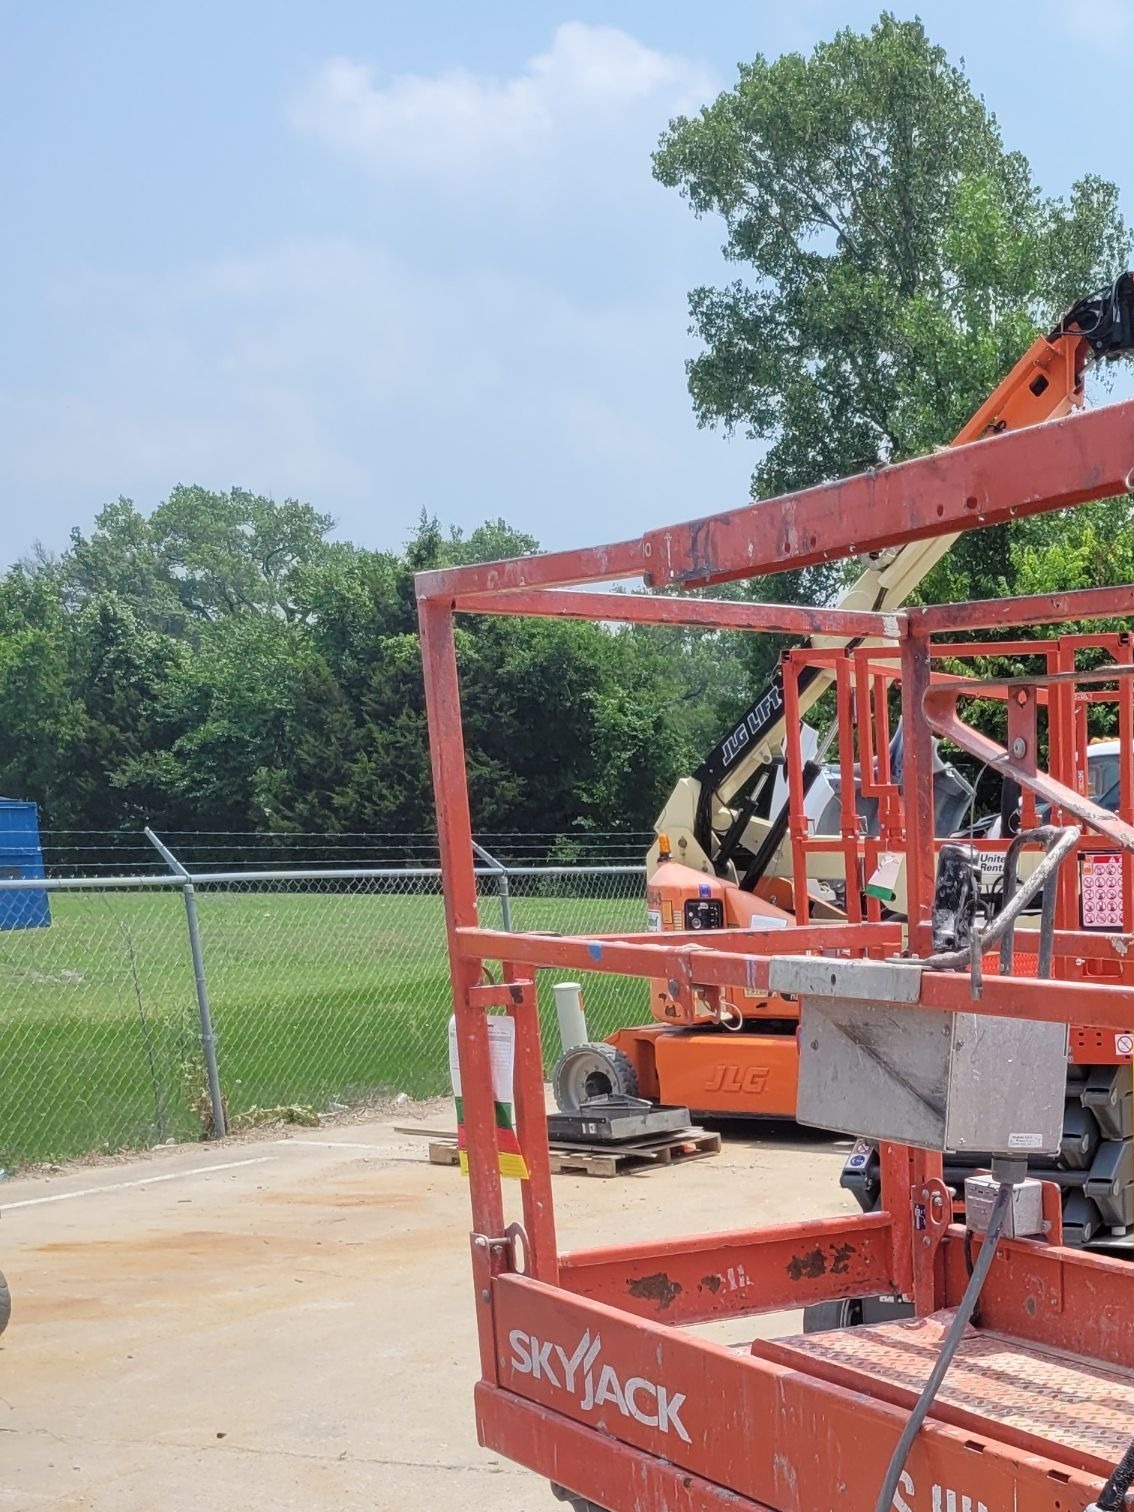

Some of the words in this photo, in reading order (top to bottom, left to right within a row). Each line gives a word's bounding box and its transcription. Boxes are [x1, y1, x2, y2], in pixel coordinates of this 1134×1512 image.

[721, 722, 750, 767] JLG
[746, 684, 782, 735] LIFT
[980, 853, 1006, 864] Unite
[980, 863, 1004, 872] Rent
[704, 1063, 770, 1095] JLG
[508, 1327, 693, 1445] SKYJACK
